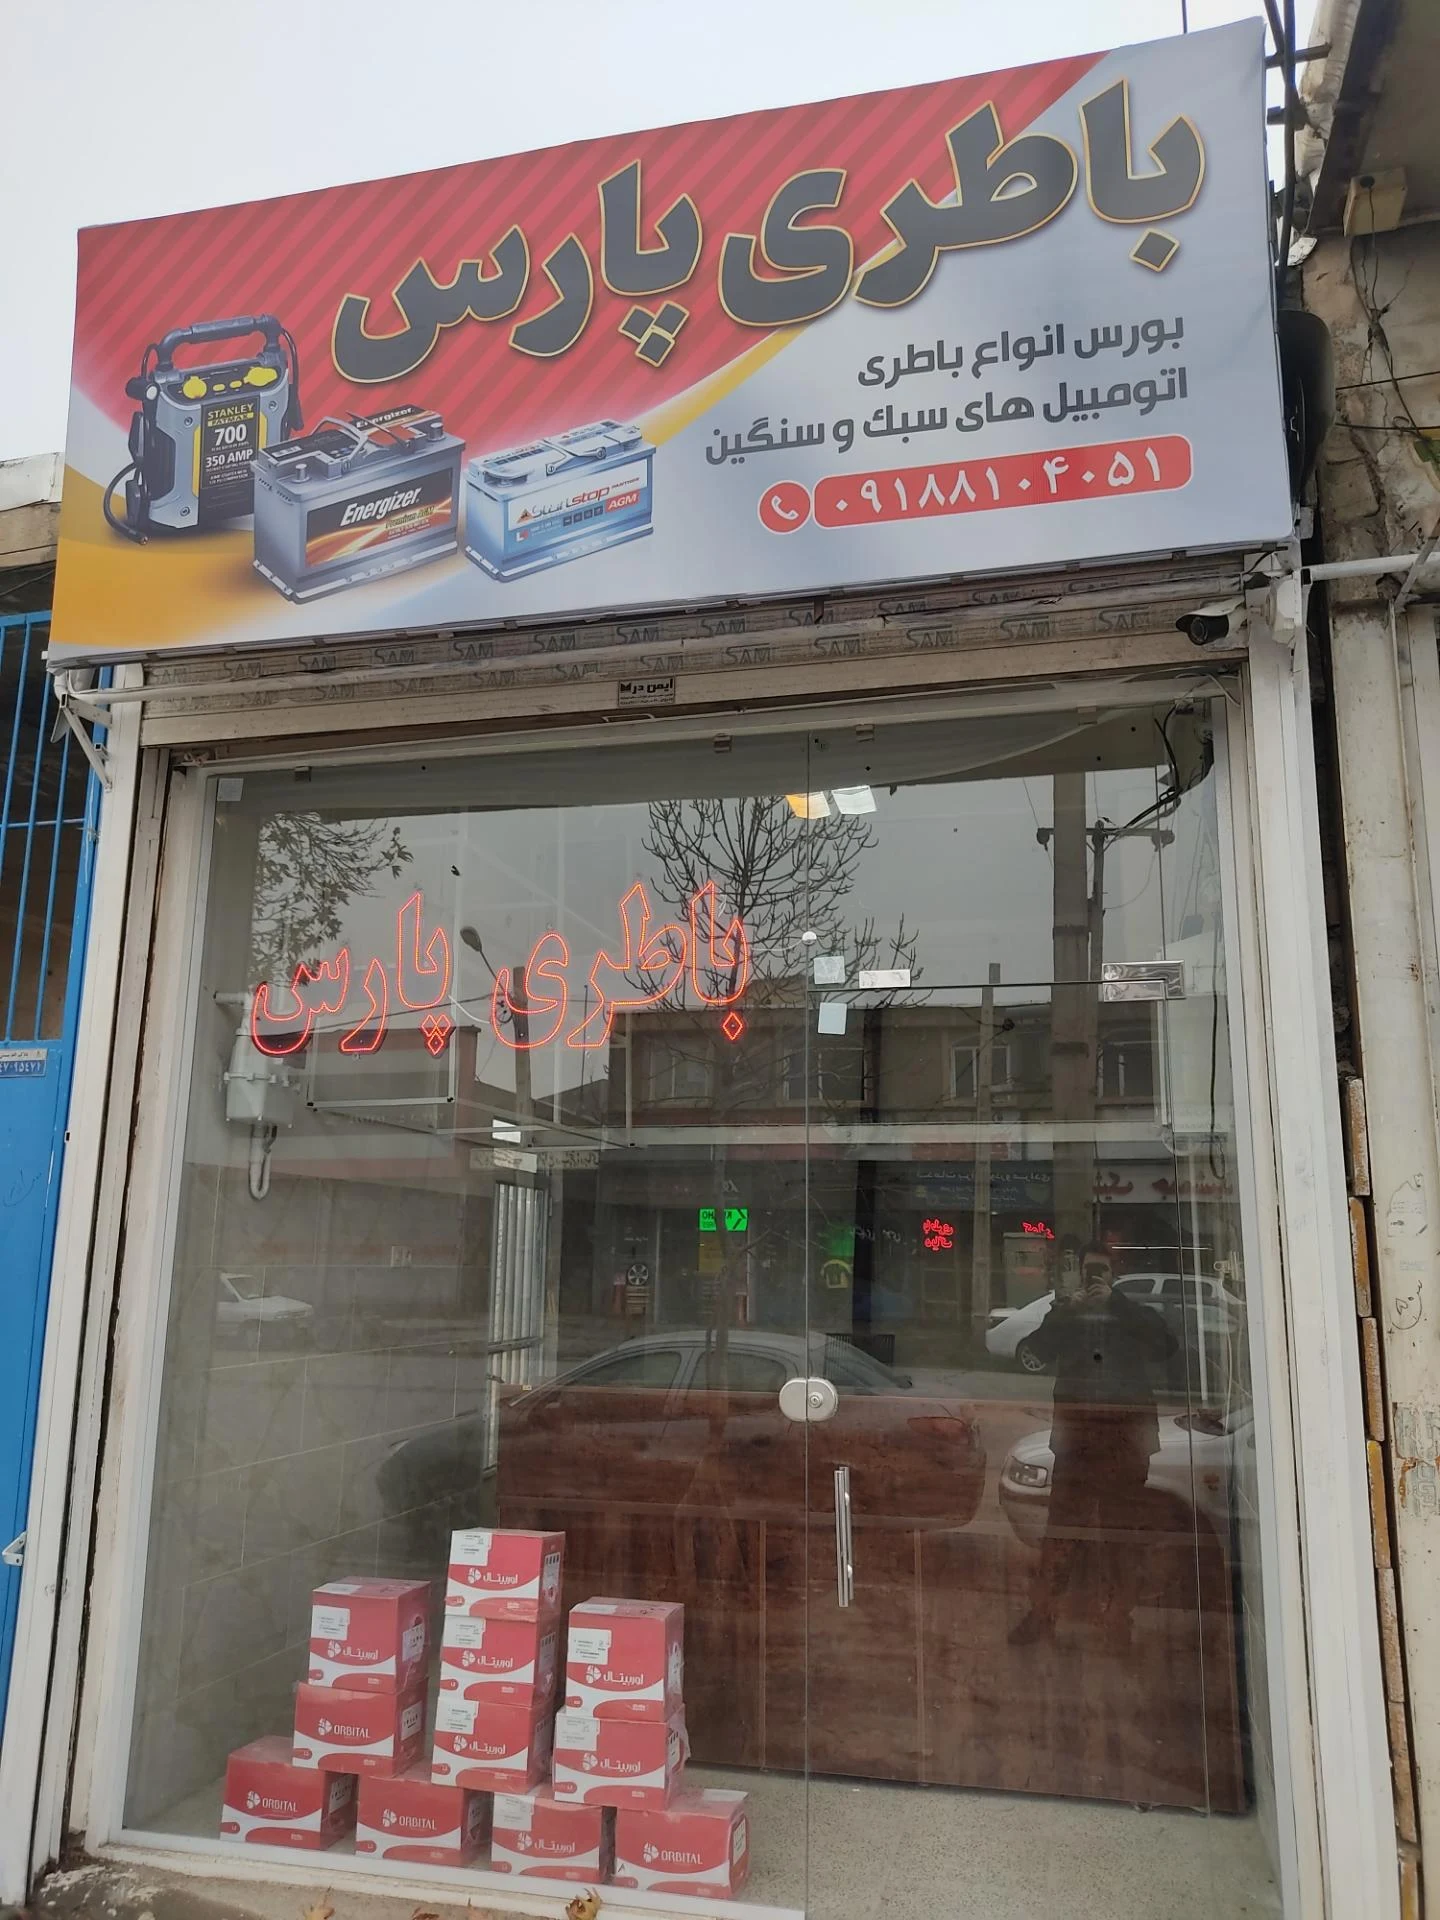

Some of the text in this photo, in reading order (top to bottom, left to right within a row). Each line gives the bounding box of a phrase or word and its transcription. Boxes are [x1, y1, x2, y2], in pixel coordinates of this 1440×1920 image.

[331, 77, 1205, 384] باطری پارس
[858, 317, 1184, 389] بورس انواع باطری
[208, 403, 254, 420] STANLEY
[955, 391, 1034, 432] های
[1042, 367, 1188, 423] اتومبیل
[214, 424, 247, 446] 700
[706, 417, 825, 465] سنگین
[832, 418, 854, 453] و
[206, 456, 226, 468] 350
[227, 449, 253, 464] AMP
[834, 447, 1162, 513] ۰۹۱۸۸۱۰۴۰۵۱
[340, 487, 421, 526] Energizer
[608, 493, 638, 510] AGM
[453, 640, 496, 660] SAM
[533, 631, 576, 653] SAM
[616, 624, 660, 645] SAM
[701, 616, 747, 637] SAM
[725, 644, 771, 665] SAM
[814, 635, 861, 657] SAM
[907, 626, 953, 649] SAM
[647, 679, 673, 693] ایمن
[250, 880, 750, 1057] باطری پارس
[333, 1724, 370, 1738] ORBITAL
[262, 1797, 298, 1812] ORBITAL
[399, 1815, 437, 1830] ORBITAL
[661, 1850, 703, 1865] ORBITAL
